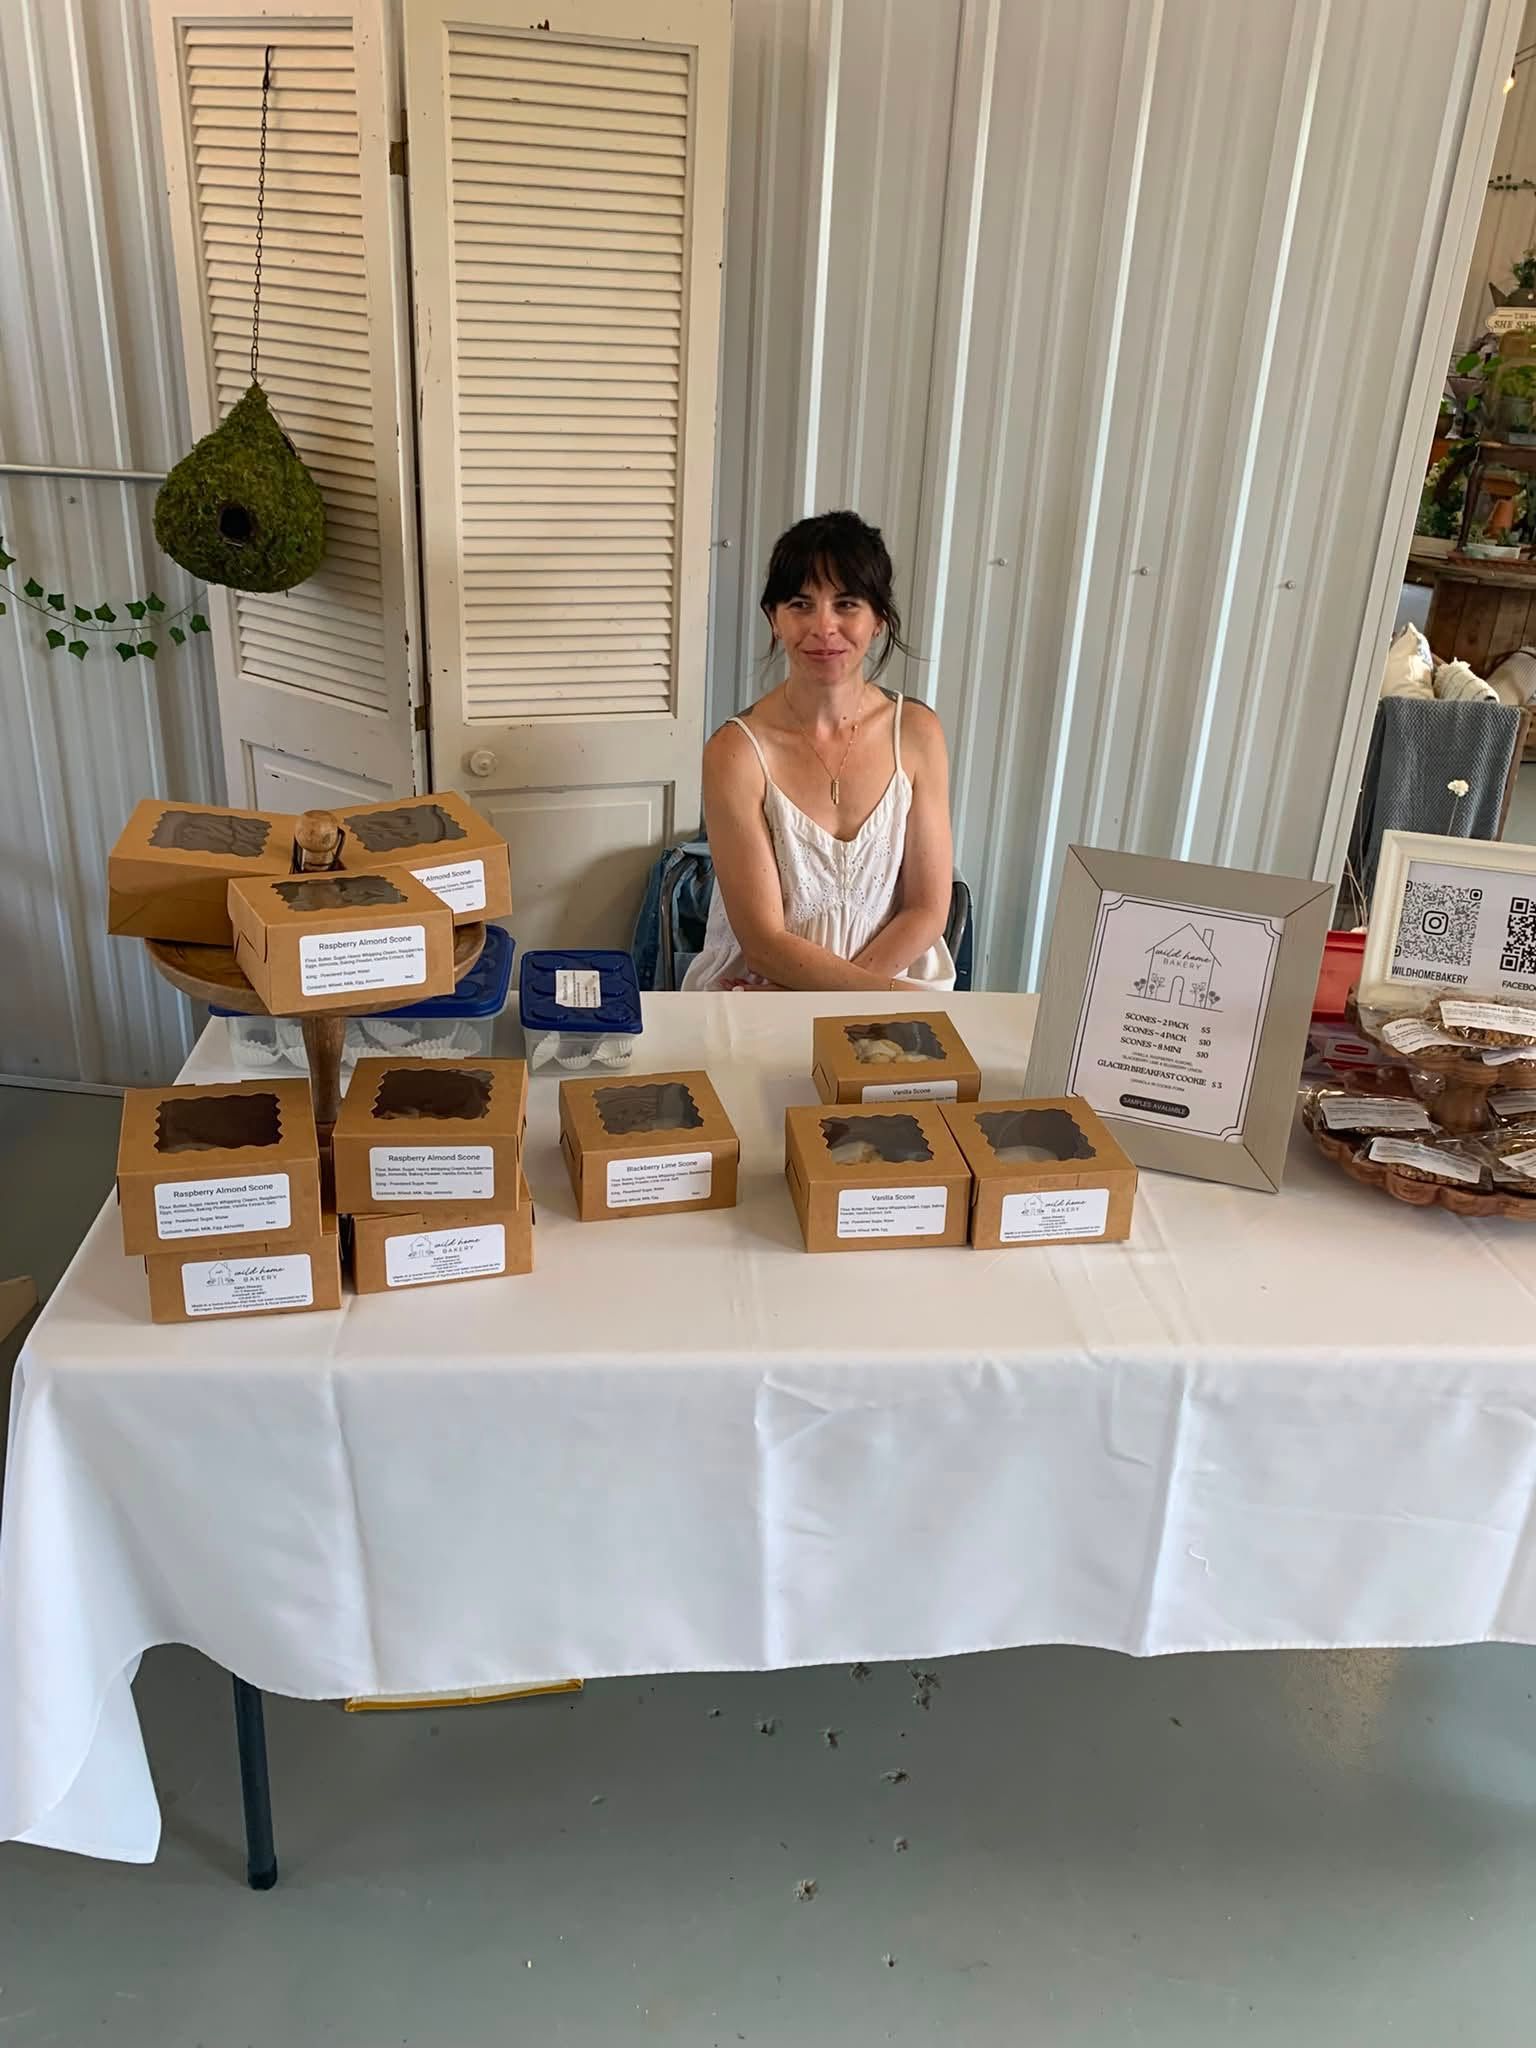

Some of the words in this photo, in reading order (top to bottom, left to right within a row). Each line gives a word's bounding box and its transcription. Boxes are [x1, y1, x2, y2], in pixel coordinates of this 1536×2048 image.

[1494, 320, 1513, 329] SHE
[426, 872, 450, 882] Almond
[452, 869, 472, 878] Scone
[318, 941, 358, 951] Raspberry
[358, 937, 388, 946] Almond
[390, 936, 412, 944] Scone
[1162, 958, 1202, 970] BAKERY
[1392, 966, 1468, 984] WILDHOMEBAKERY
[1502, 980, 1536, 992] FACEBO
[1125, 1012, 1157, 1024] SCONES
[1168, 1020, 1190, 1030] PACK
[1122, 1024, 1154, 1036] SCONES
[1166, 1032, 1187, 1042] PACK
[1120, 1036, 1152, 1048] SCONES
[1164, 1044, 1182, 1054] MINI
[1097, 1058, 1130, 1072] GLACIER
[1131, 1064, 1175, 1080] BREAKFAST
[1176, 1074, 1206, 1086] COOKIE
[388, 1154, 426, 1162] Raspberry
[626, 1164, 660, 1172] Blackberry
[174, 1188, 214, 1198] Raspberry
[216, 1185, 247, 1194] Almond
[248, 1184, 274, 1192] Scone
[442, 1245, 474, 1254] BAKERY
[243, 1272, 278, 1282] BAKERY
